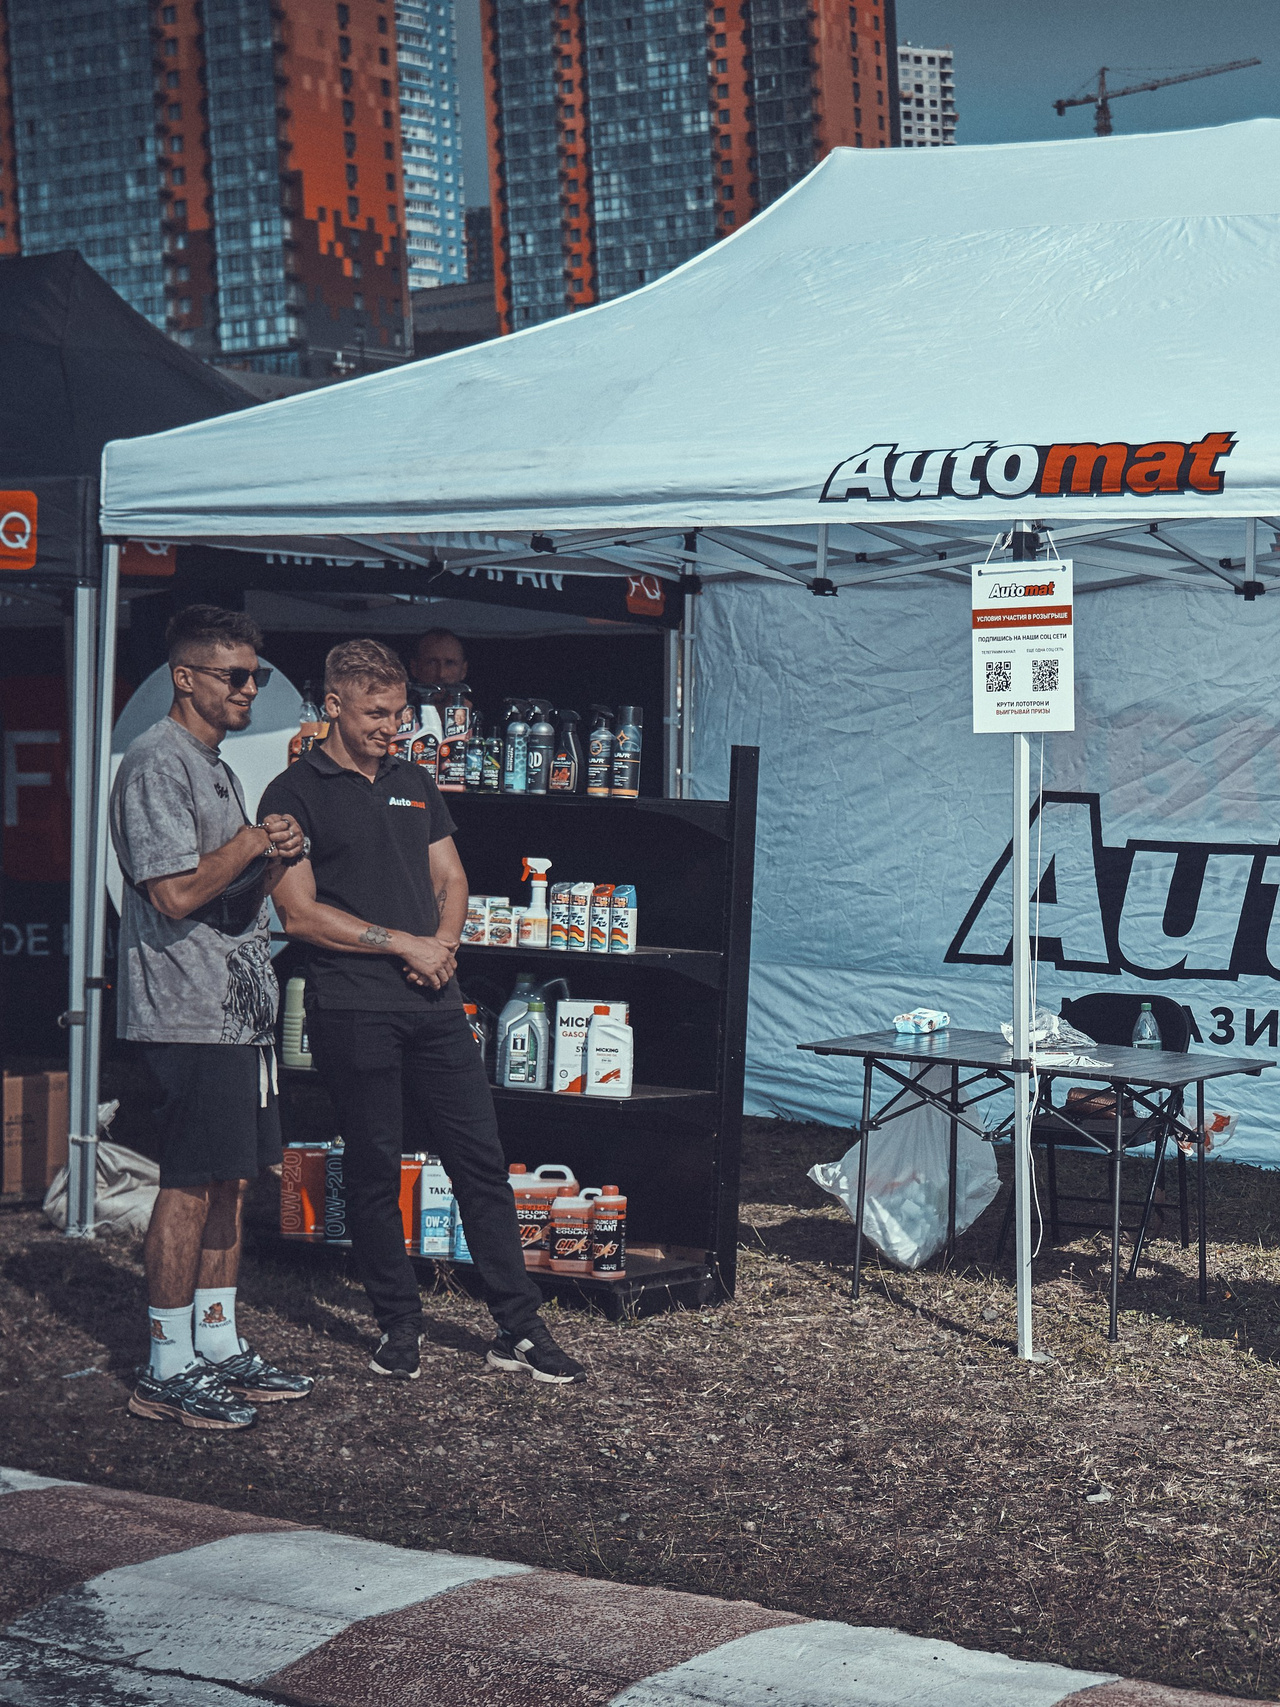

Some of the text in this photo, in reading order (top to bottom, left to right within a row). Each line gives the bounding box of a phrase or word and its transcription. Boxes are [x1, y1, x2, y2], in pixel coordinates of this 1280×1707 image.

[818, 431, 1240, 503] Automat
[989, 581, 1055, 599] Automat
[976, 614, 1002, 623] УСЛОВИЯ
[1002, 613, 1027, 622] УЧАСТИЯ
[1032, 611, 1069, 620] РОЗЫГРЫШЕ
[978, 635, 1013, 643] ПОДПИШИСЬ
[1040, 633, 1052, 641] СОЦ
[996, 707, 1051, 716] ВЫИГРЫВАЙ ПРИЗЫ
[425, 1216, 455, 1227] 0W-20
